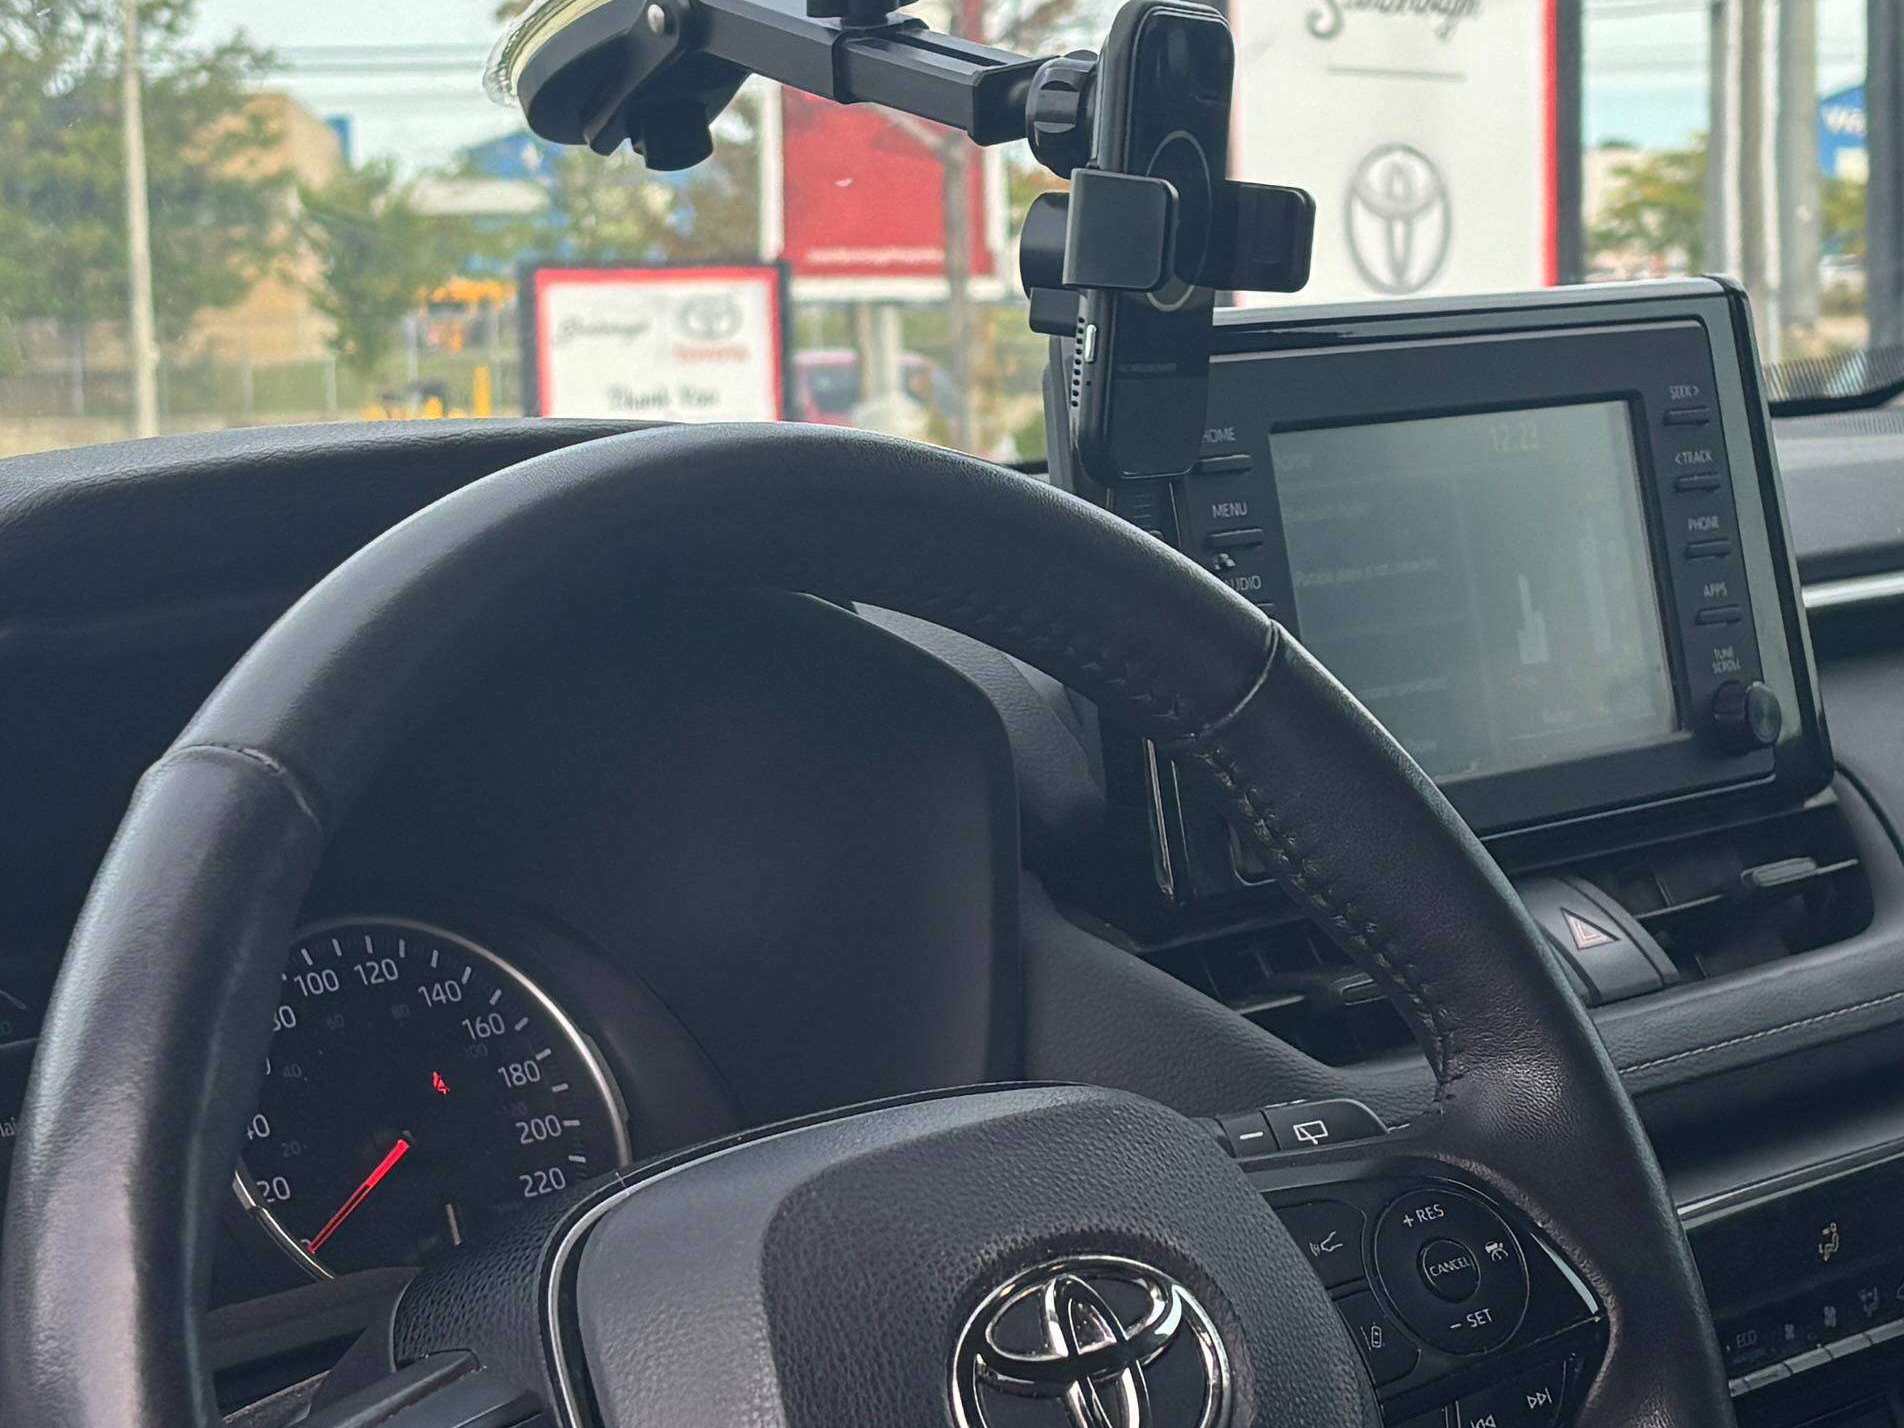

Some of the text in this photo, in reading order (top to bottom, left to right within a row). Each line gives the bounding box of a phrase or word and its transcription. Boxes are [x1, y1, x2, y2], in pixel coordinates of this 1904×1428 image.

[1211, 501, 1248, 519] MENU
[1227, 574, 1262, 592] UDIO
[1703, 581, 1728, 597] APPS
[293, 968, 341, 998] 100
[353, 958, 399, 987] 120
[417, 979, 463, 1008] 140
[461, 1011, 506, 1041] 160
[497, 1059, 542, 1088] 180
[514, 1114, 563, 1145] 200
[256, 1175, 292, 1204] 20
[519, 1167, 567, 1198] 220
[1415, 1203, 1446, 1225] RES
[1428, 1255, 1472, 1278] CANCEL
[1465, 1307, 1494, 1329] SET
